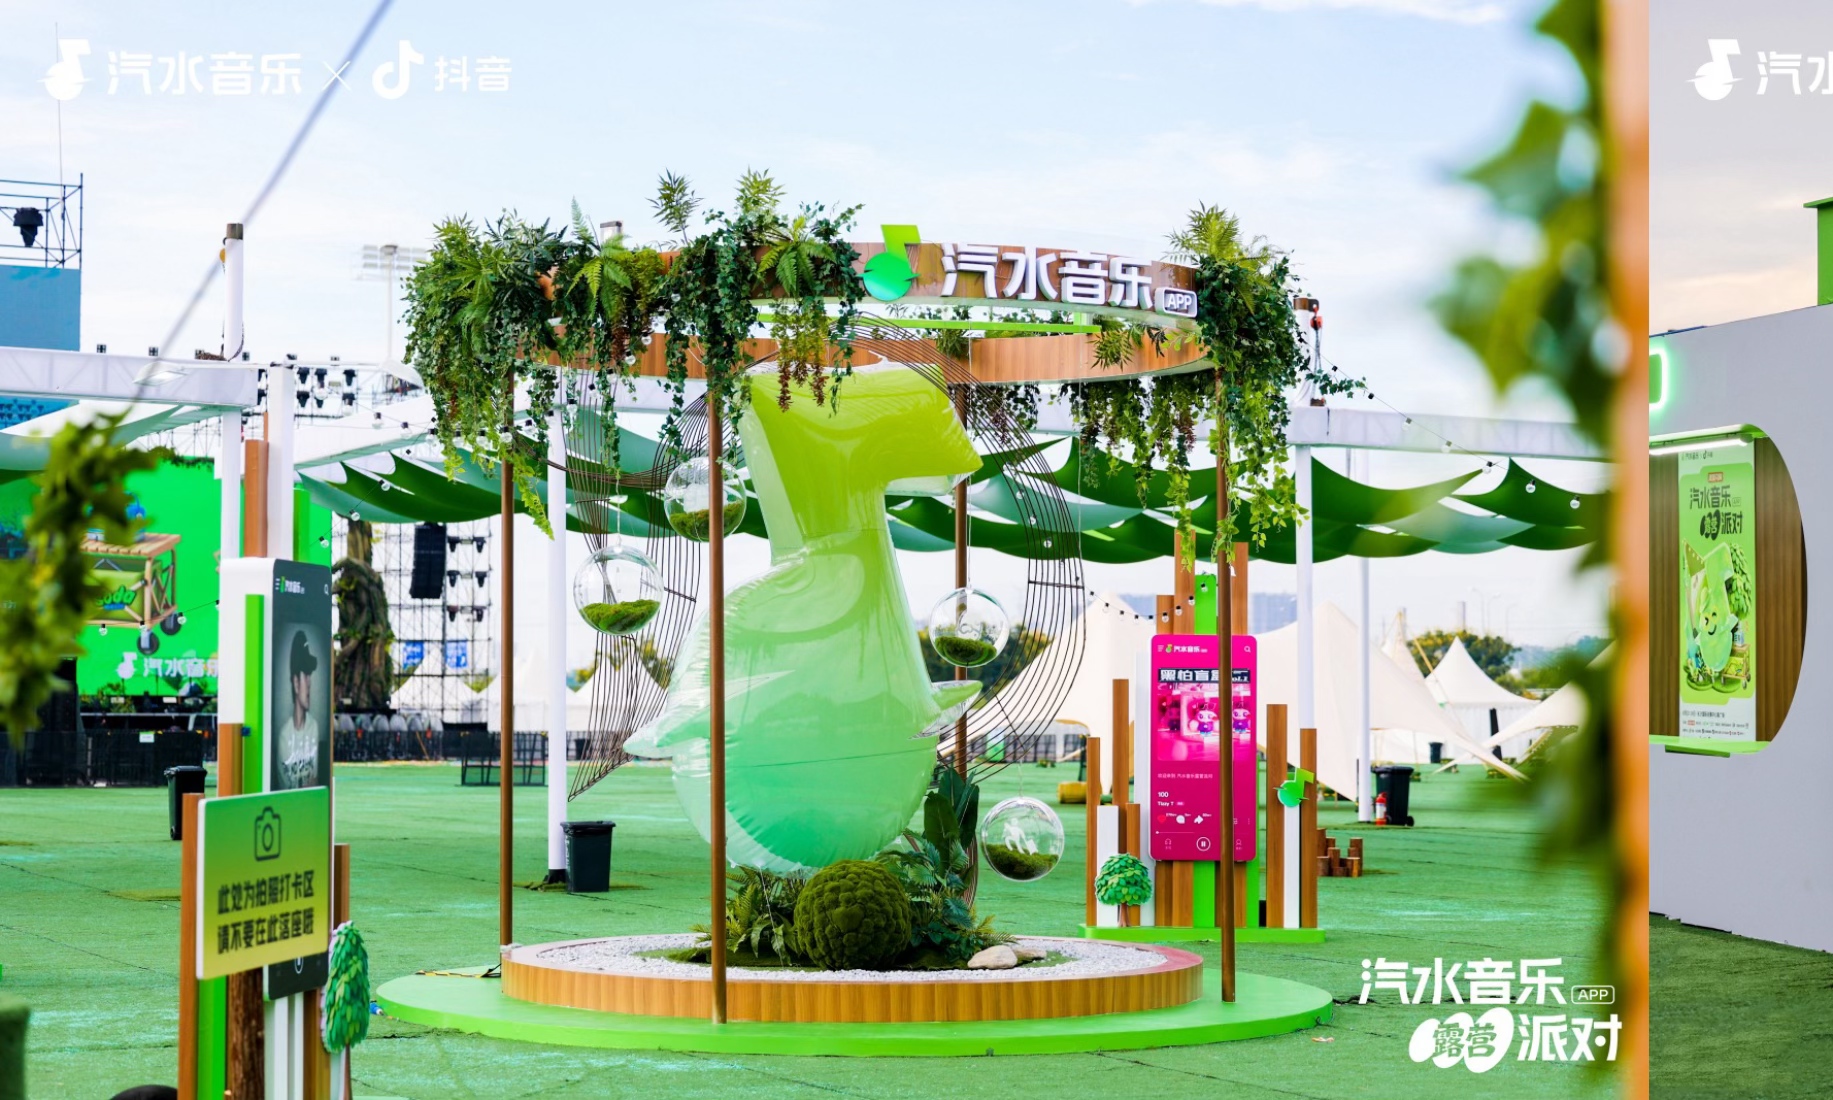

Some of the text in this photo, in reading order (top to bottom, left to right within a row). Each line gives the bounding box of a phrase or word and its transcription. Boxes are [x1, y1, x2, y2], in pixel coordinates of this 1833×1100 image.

[940, 242, 1193, 310] 汽水音乐 APP
[1689, 485, 1732, 509] 汽水音乐
[217, 870, 314, 914] 此处为拍照打卡区
[217, 907, 314, 954] 请不要在此落座哦
